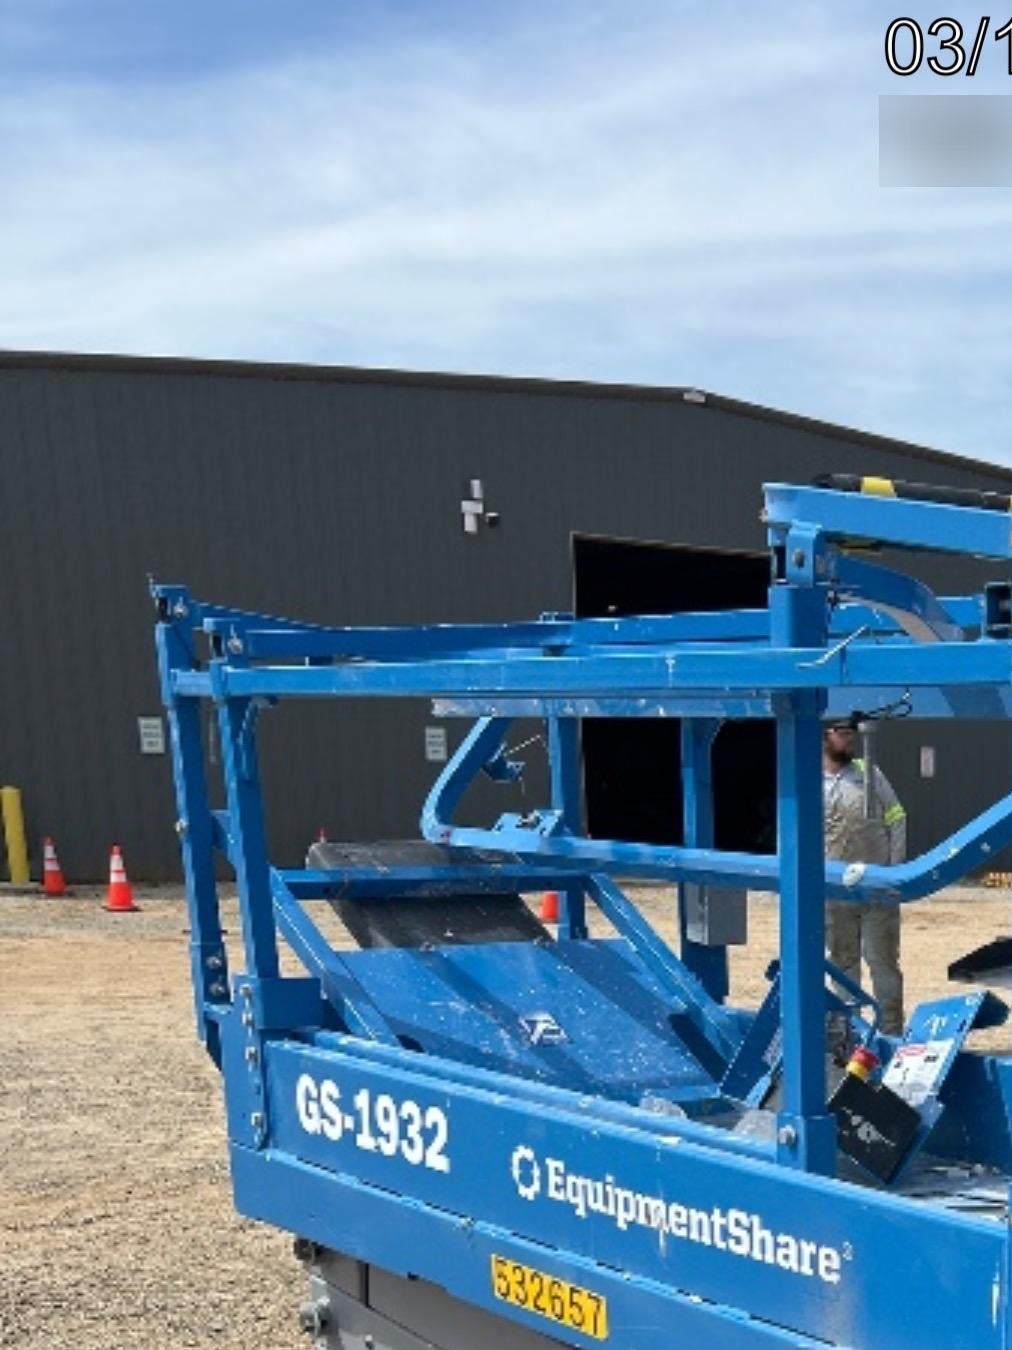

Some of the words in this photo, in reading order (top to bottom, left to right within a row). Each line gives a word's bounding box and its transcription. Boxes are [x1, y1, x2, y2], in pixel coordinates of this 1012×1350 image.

[295, 1073, 451, 1174] GS-1932
[545, 1157, 843, 1284] EquipmentShare
[495, 1260, 602, 1335] 532657
